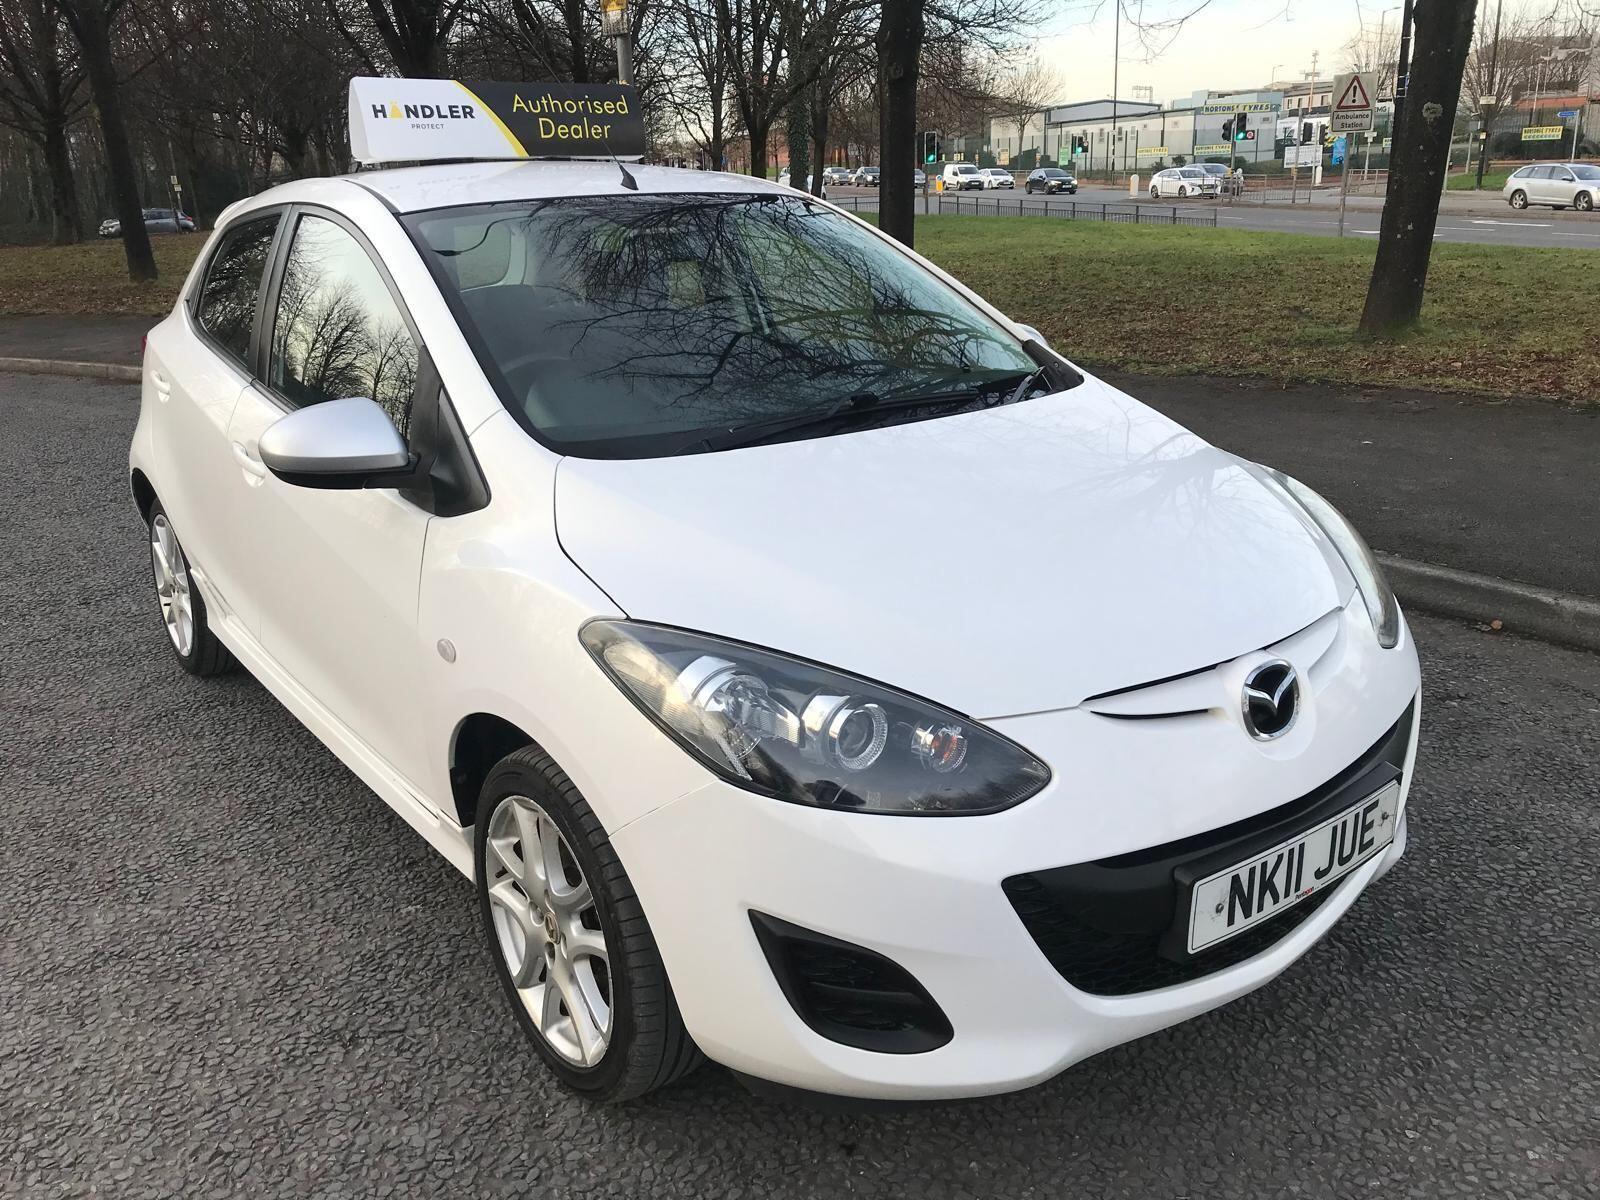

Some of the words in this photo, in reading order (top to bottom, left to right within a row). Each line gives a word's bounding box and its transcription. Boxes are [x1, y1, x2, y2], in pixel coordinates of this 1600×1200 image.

[512, 93, 629, 115] Authorised
[1243, 103, 1271, 112] TYRES
[1336, 112, 1369, 120] Ambulance
[538, 117, 611, 140] Dealer
[1340, 121, 1364, 129] Station
[1227, 841, 1306, 928] NK11
[1314, 799, 1380, 881] JUE
